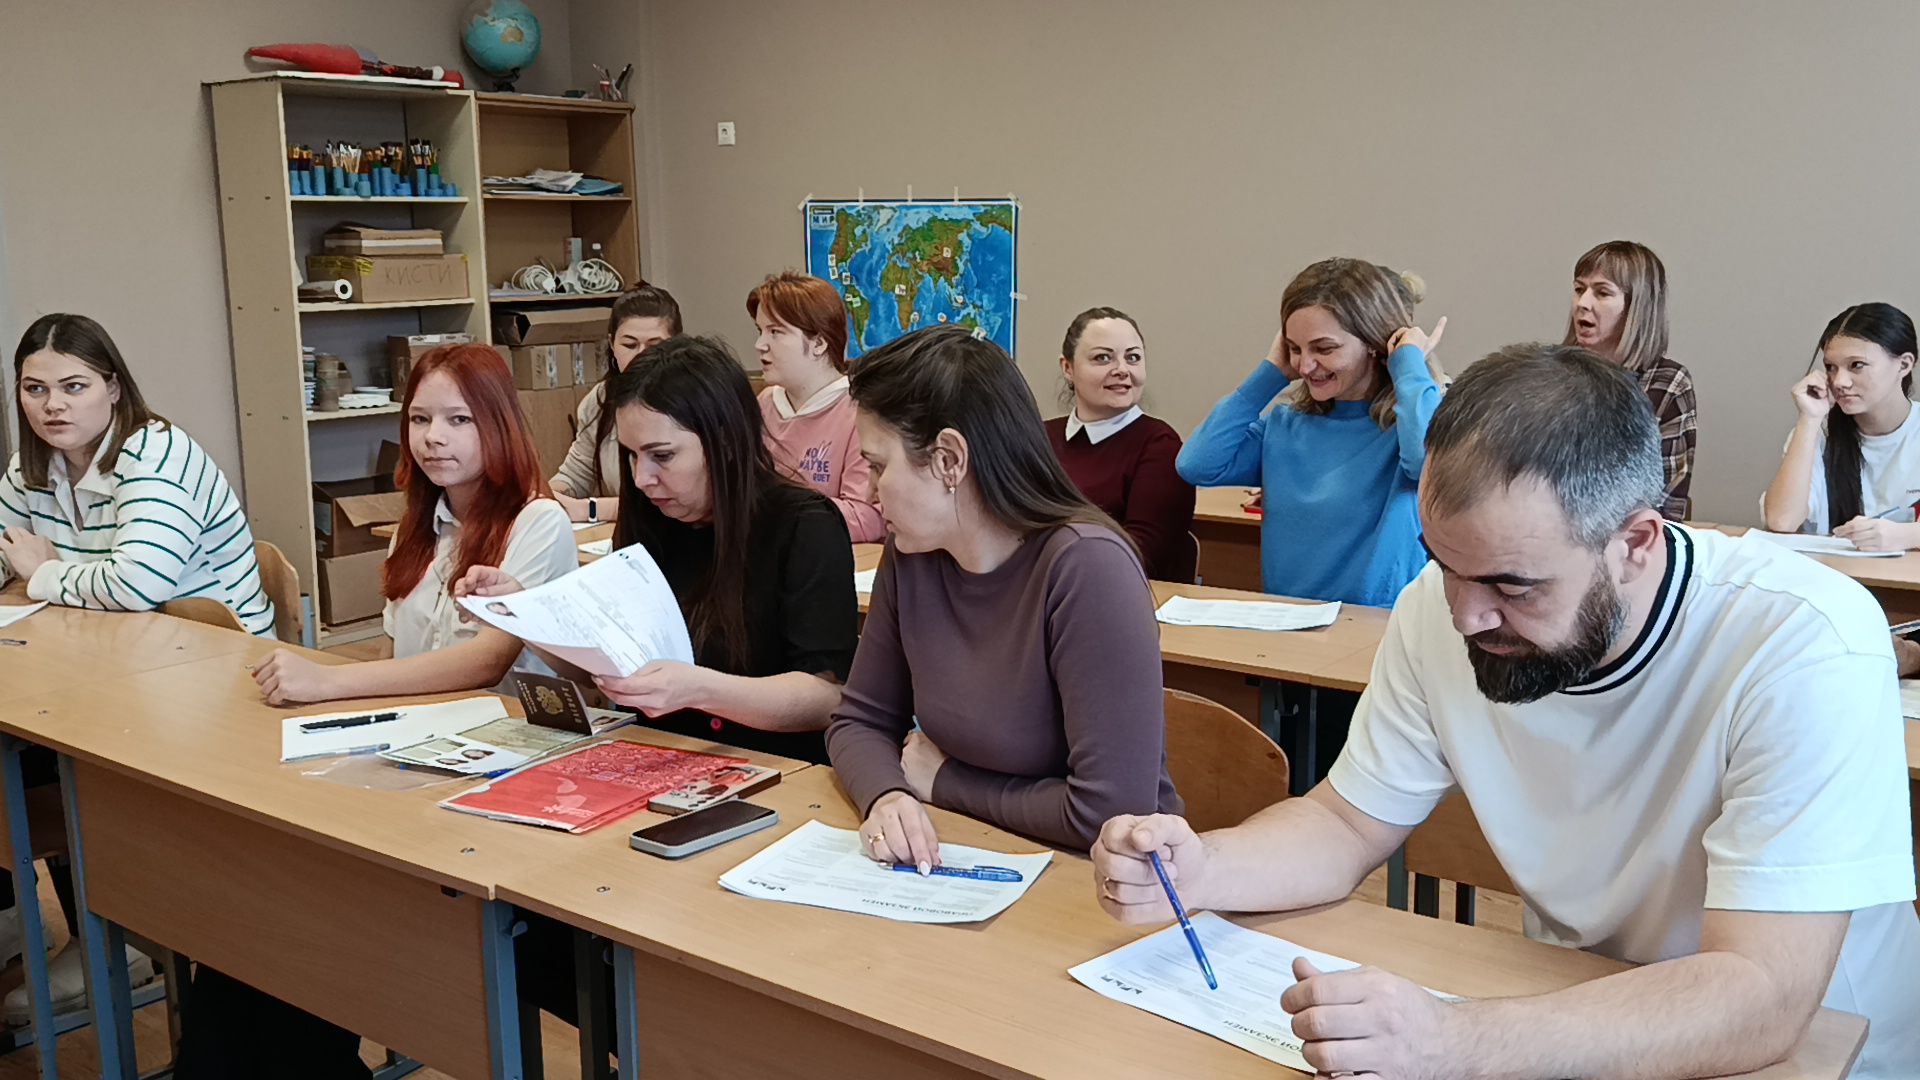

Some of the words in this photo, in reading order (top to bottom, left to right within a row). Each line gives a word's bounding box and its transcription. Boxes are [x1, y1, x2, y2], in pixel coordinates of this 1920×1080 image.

[812, 215, 835, 224] МИР
[384, 263, 453, 288] КИСТИ
[1223, 1020, 1280, 1044] ЭКЗАМЕН
